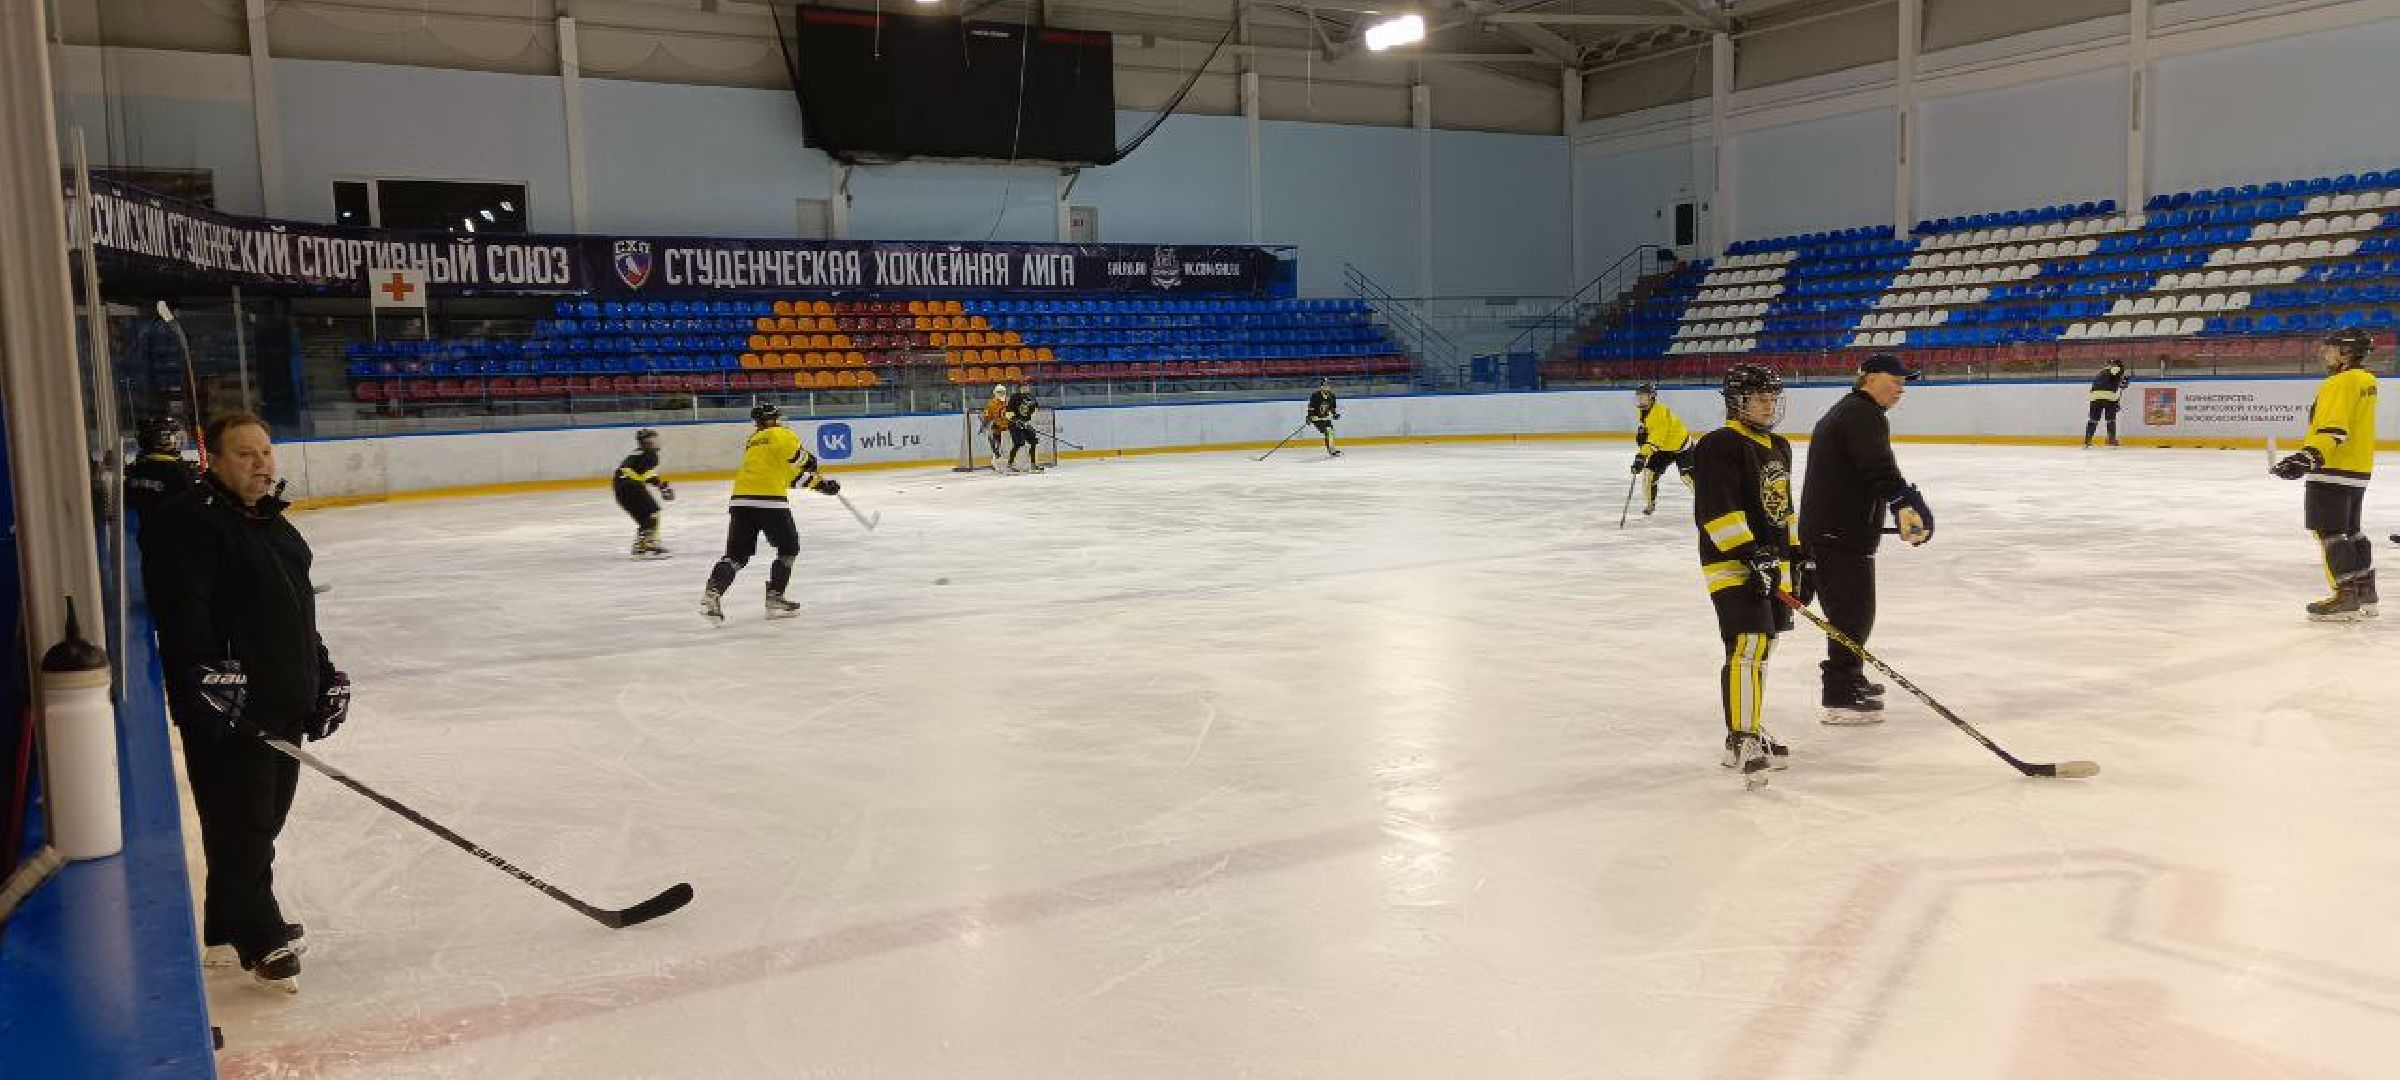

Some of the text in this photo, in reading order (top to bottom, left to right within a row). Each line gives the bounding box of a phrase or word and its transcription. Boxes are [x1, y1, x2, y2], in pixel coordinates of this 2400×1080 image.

[298, 235, 478, 283] СПОРТИВНЫЙ
[487, 245, 571, 284] СОЮЗ
[664, 246, 1075, 289] СТУДЕНЧЕСКАЯ ХОККЕЙНАЯ ЛИГА
[859, 430, 921, 451] whl_ru
